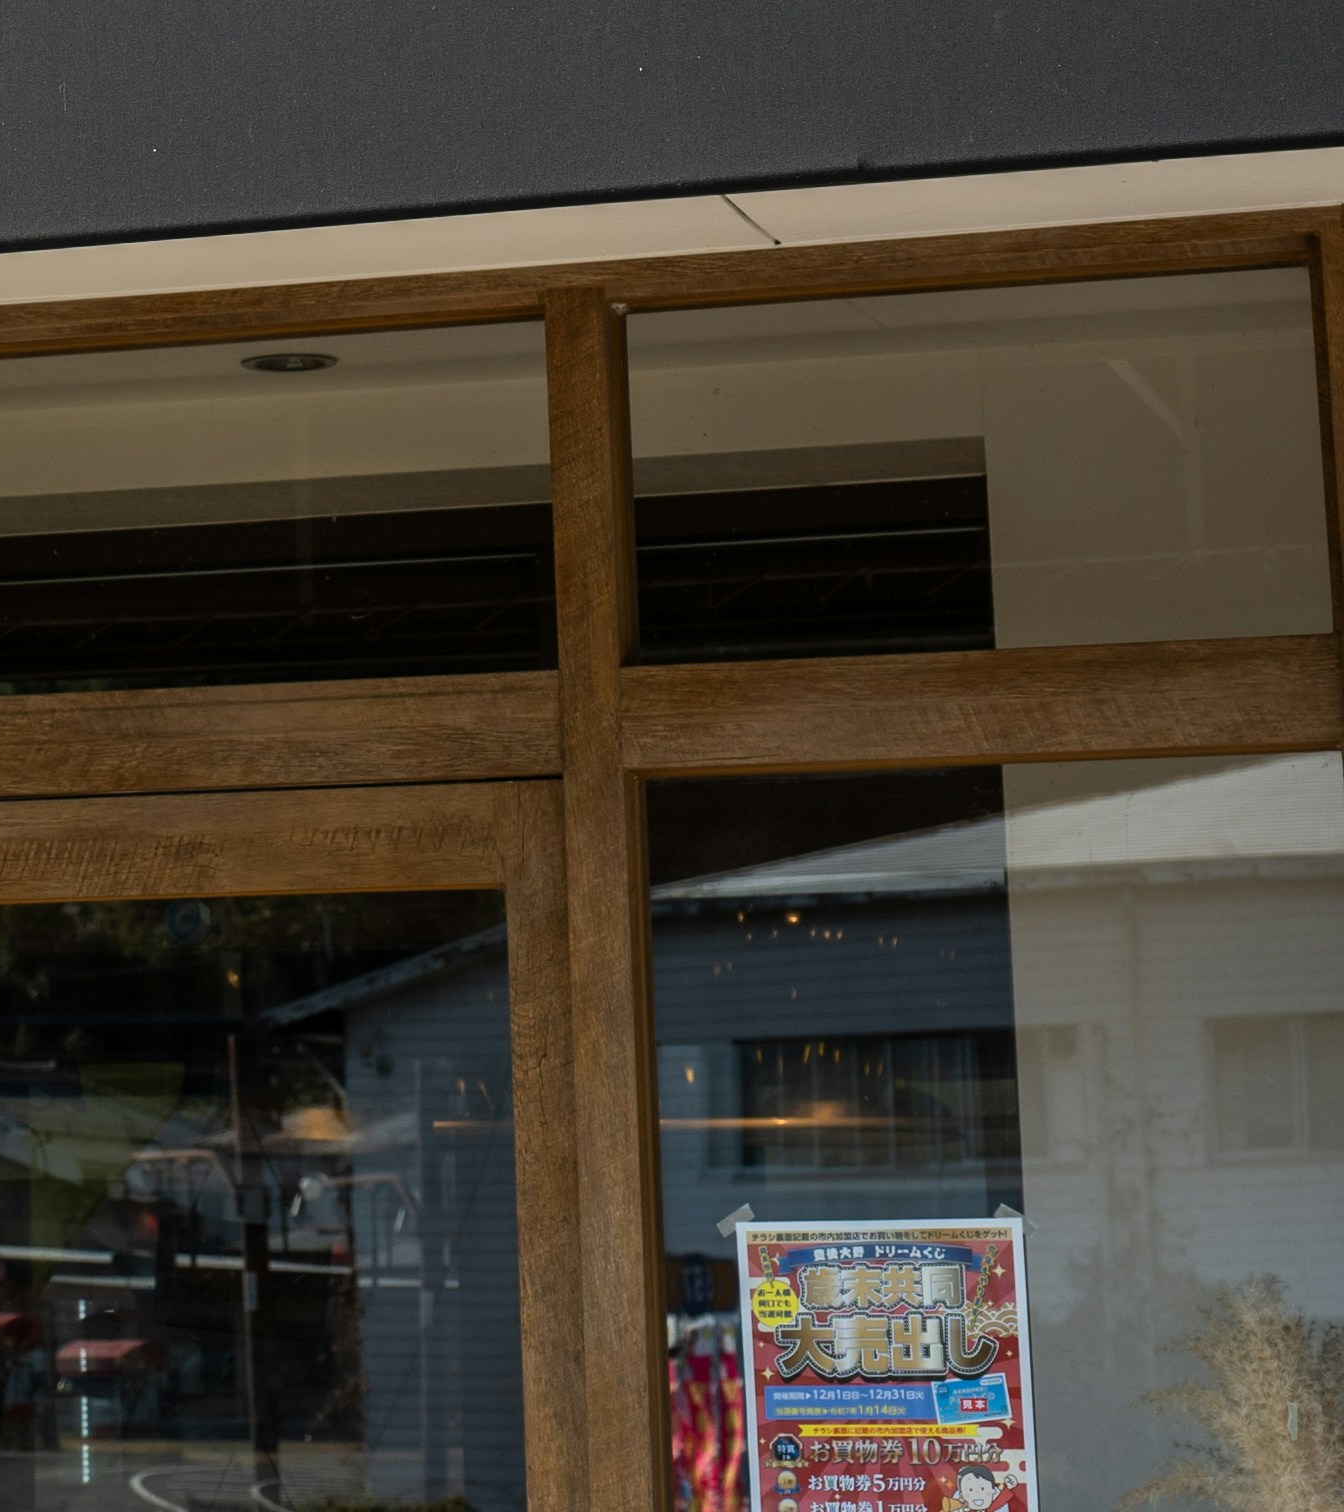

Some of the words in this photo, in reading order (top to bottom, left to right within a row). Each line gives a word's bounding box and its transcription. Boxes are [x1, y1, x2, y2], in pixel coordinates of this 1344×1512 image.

[874, 1246, 947, 1260] ドリームくじ
[802, 1265, 962, 1308] 歳末共同
[781, 1315, 998, 1374] 大売出し
[961, 1399, 986, 1411] 見本
[810, 1438, 1003, 1465] お買物券10万円分
[808, 1474, 926, 1492] お買物券5万円分
